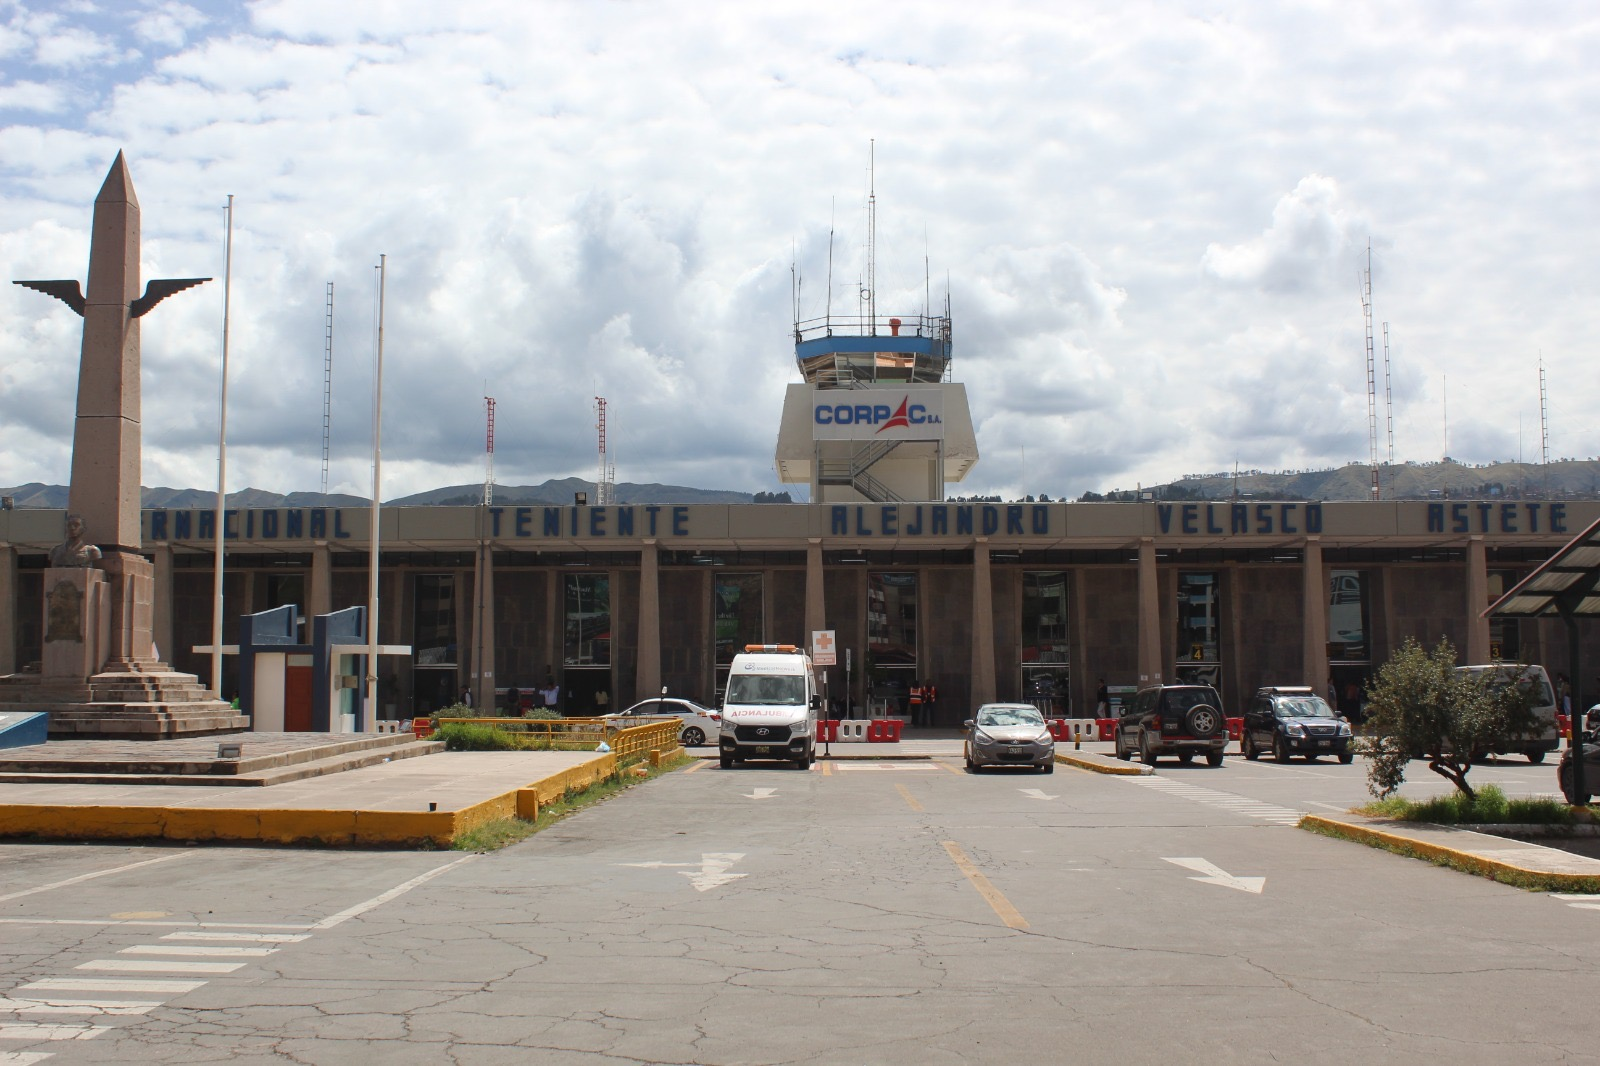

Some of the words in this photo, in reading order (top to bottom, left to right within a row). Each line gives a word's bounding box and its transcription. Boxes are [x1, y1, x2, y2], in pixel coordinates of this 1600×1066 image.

[815, 394, 926, 434] CORPAC
[141, 508, 350, 539] RNACIONAL
[490, 506, 688, 537] TENIENTE
[832, 503, 1048, 535] ALEJANDRO
[1158, 502, 1322, 533] VELASCO
[1428, 502, 1567, 533] ASTETE
[1194, 649, 1202, 660] 4
[1492, 647, 1499, 657] 3
